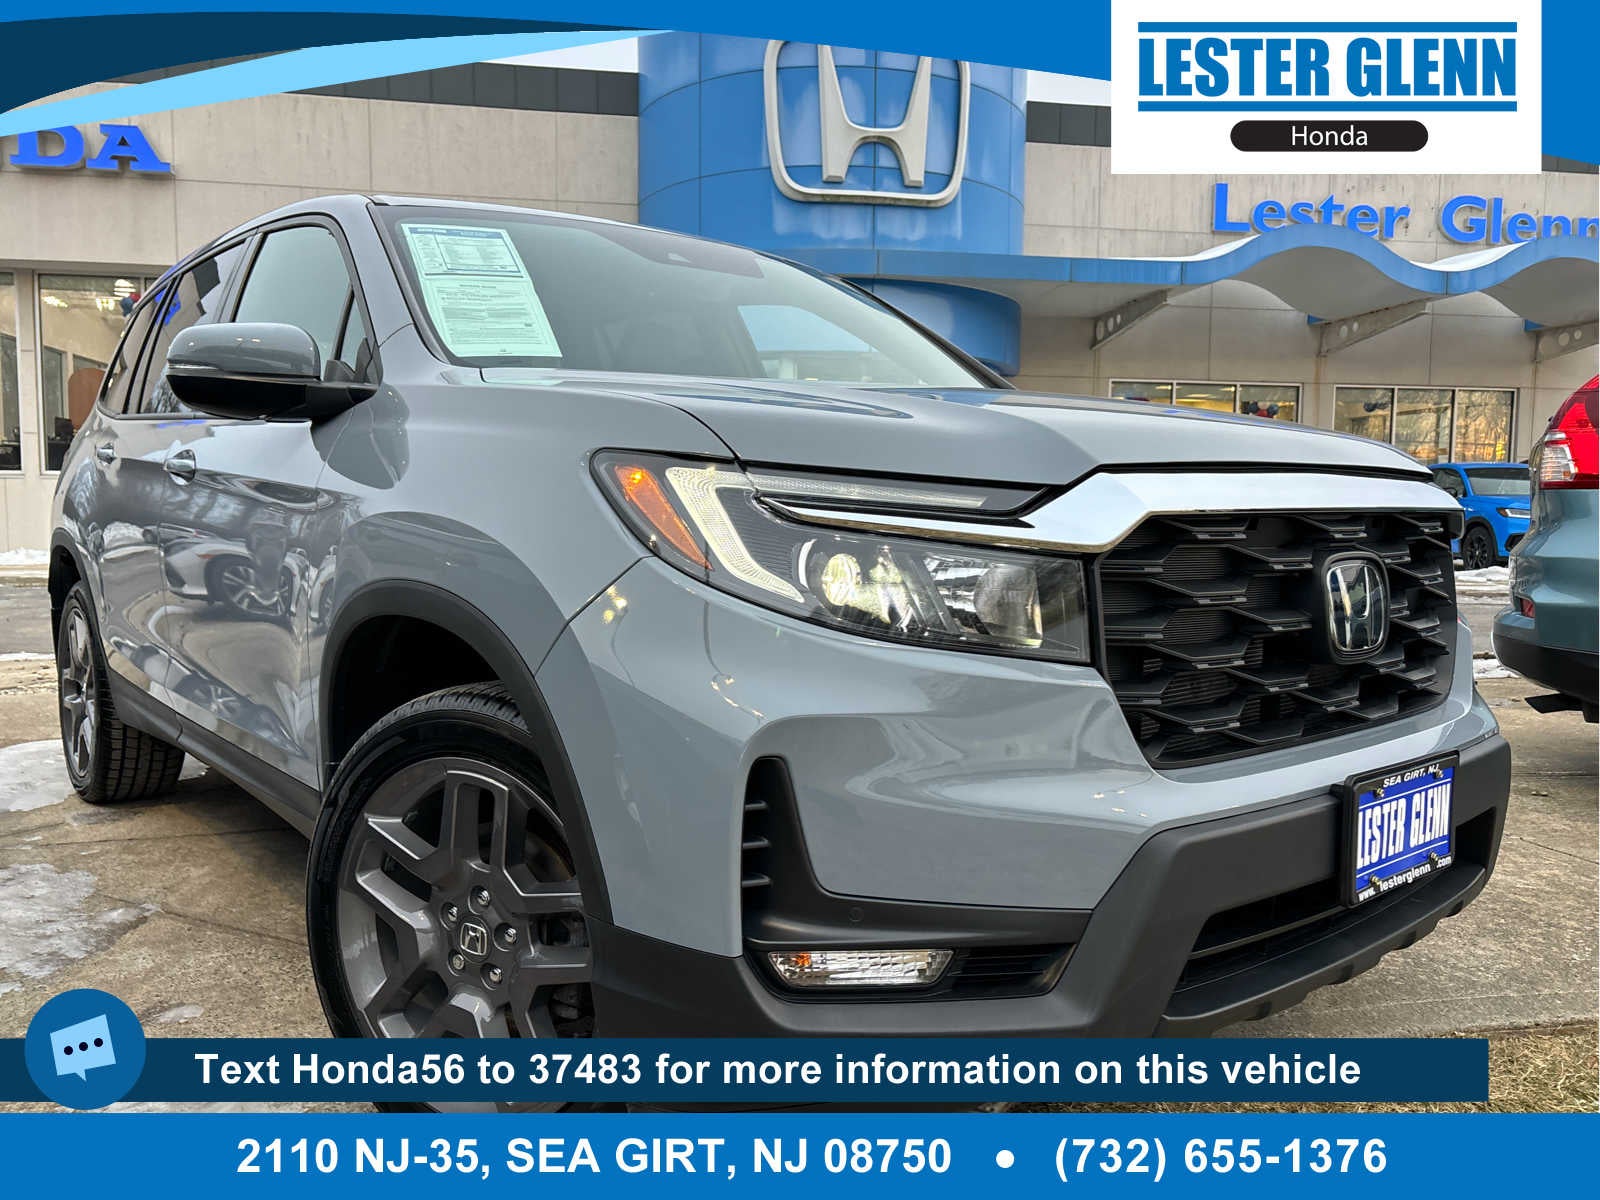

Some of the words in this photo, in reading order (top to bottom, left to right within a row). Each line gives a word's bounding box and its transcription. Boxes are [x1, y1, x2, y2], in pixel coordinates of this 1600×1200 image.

[1213, 183, 1411, 239] Lester
[1382, 775, 1402, 788] SEA
[1404, 767, 1426, 782] GIRT,
[1356, 797, 1407, 869] LESTER
[1409, 783, 1451, 848] GLENN
